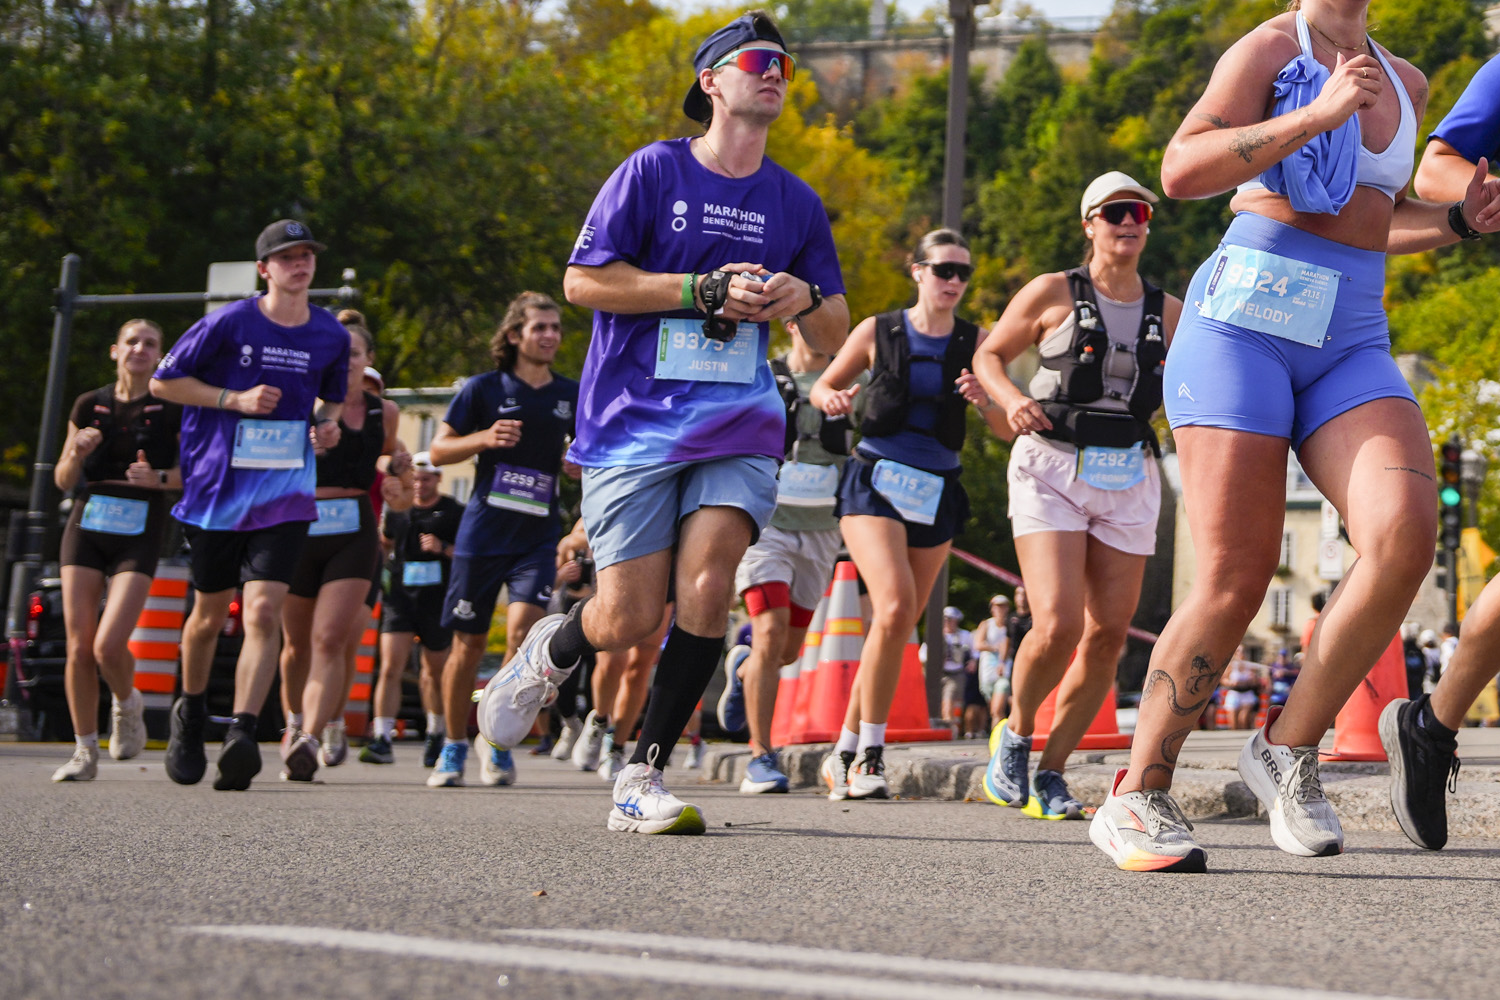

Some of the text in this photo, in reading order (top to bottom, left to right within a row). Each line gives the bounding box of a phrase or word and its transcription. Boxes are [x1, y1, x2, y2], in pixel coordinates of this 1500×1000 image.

[1226, 263, 1290, 298] 9324
[1233, 299, 1294, 326] MELODY
[687, 359, 729, 372] JUSTIN
[1087, 451, 1128, 467] 7292
[501, 470, 535, 488] 2259
